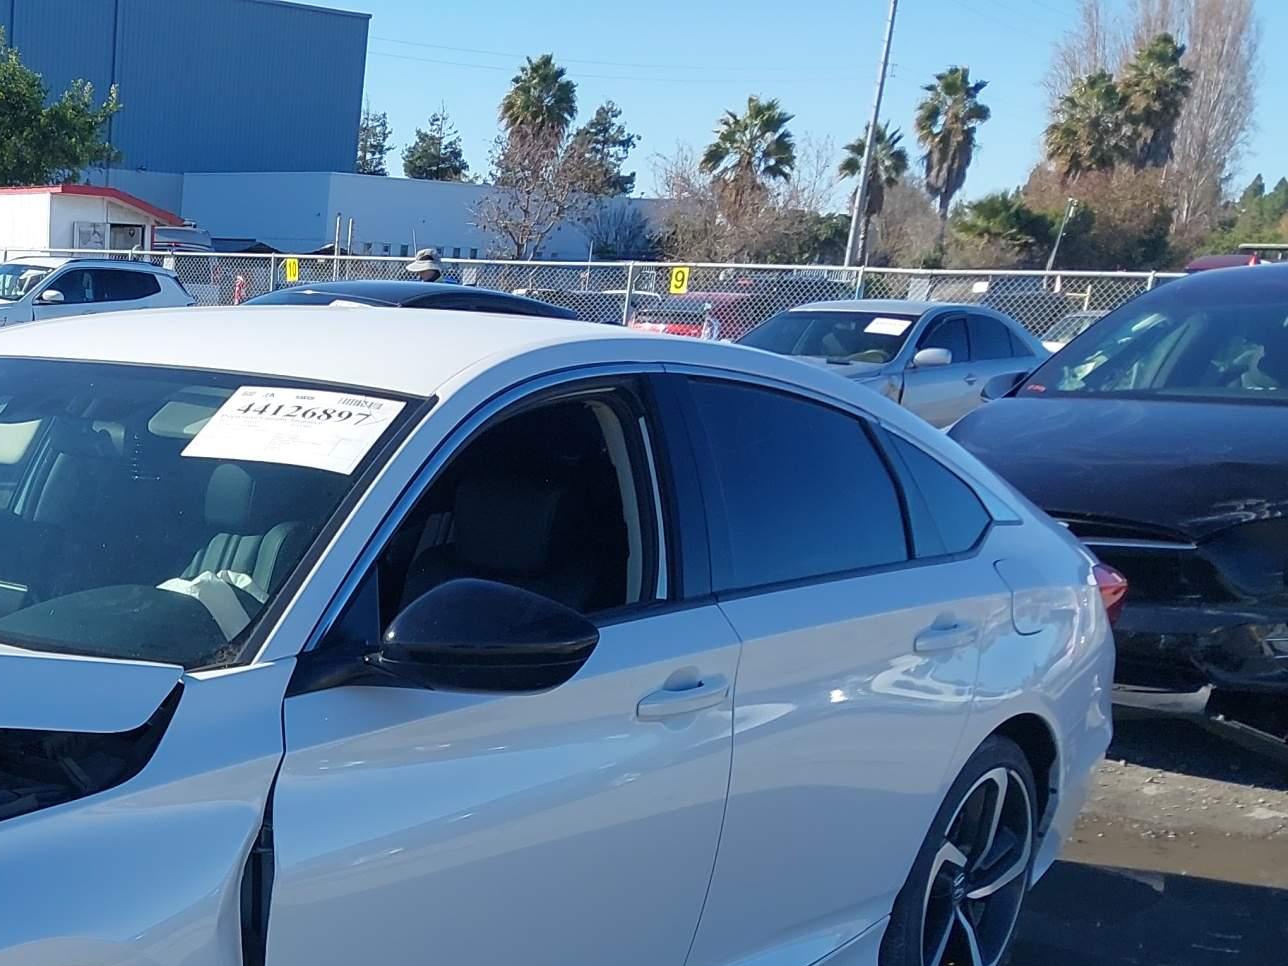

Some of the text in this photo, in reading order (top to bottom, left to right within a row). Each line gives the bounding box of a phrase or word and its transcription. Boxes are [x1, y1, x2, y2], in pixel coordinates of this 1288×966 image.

[288, 261, 297, 278] 10
[674, 270, 685, 289] 9
[237, 402, 372, 425] 44126897
